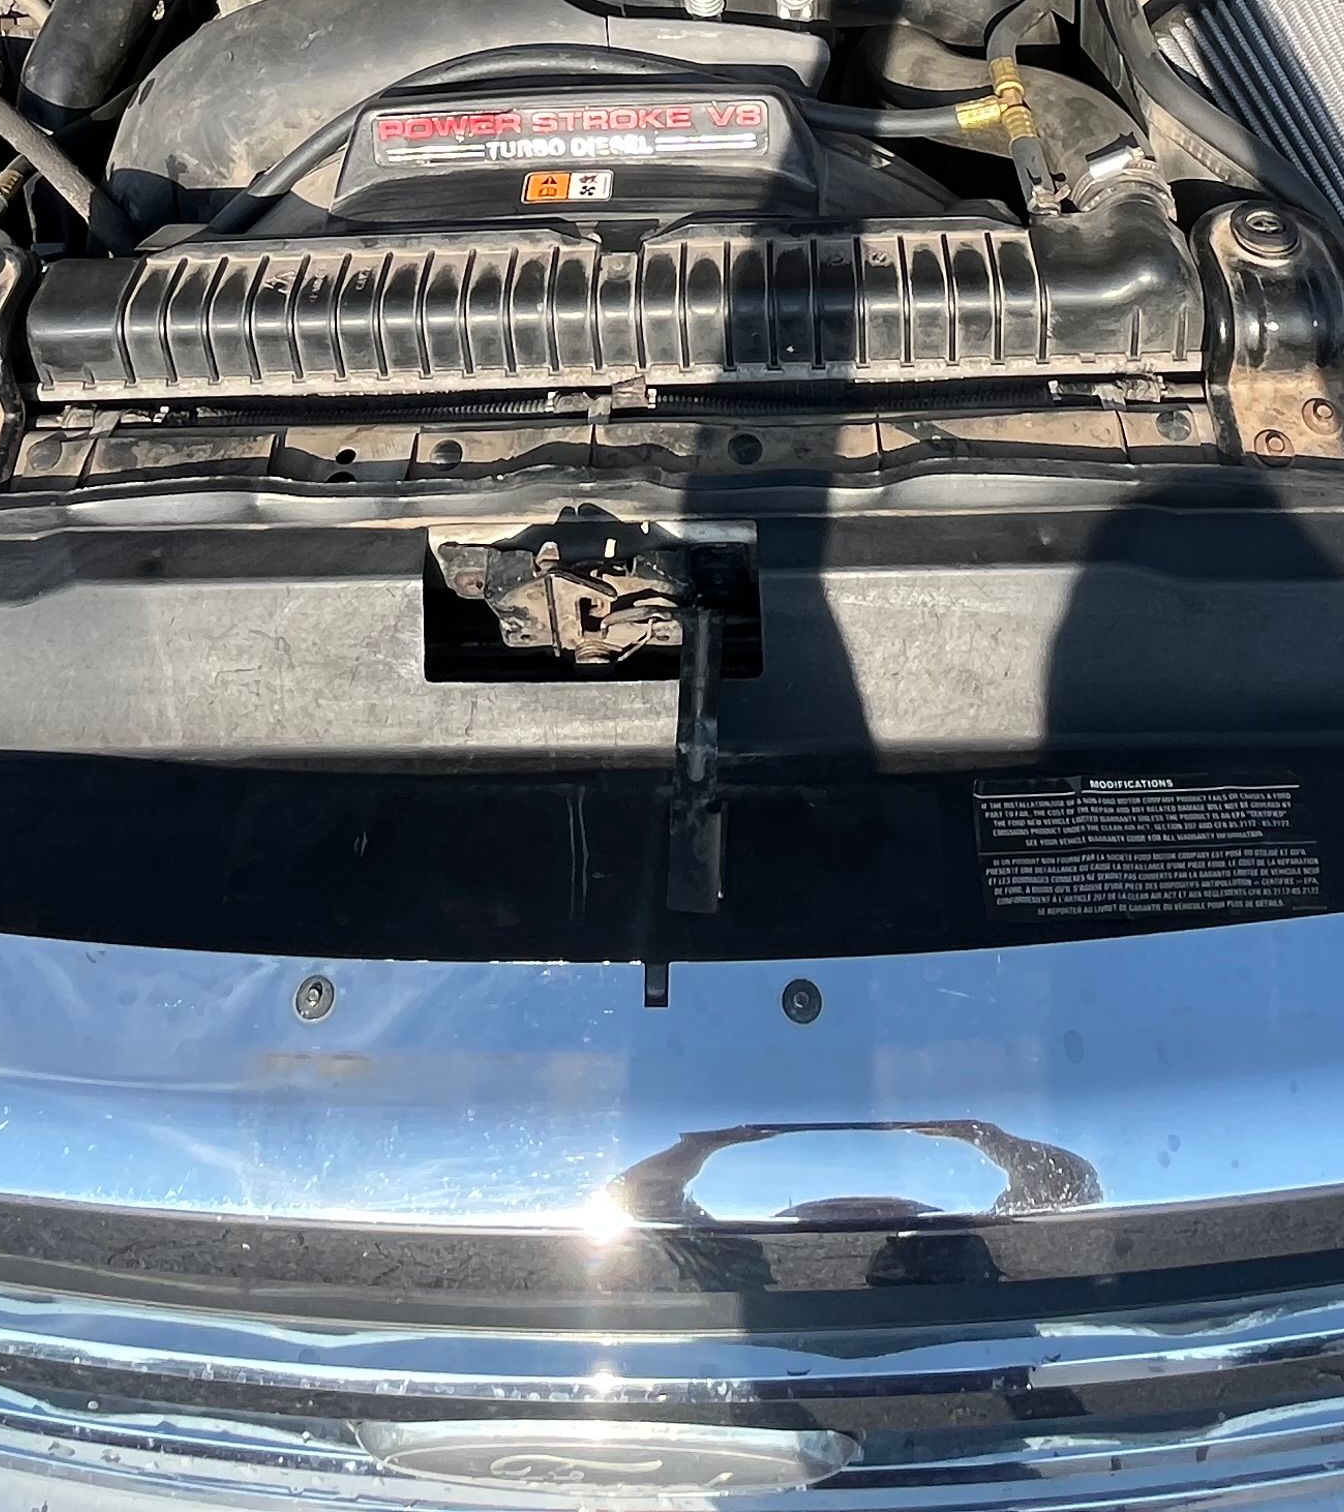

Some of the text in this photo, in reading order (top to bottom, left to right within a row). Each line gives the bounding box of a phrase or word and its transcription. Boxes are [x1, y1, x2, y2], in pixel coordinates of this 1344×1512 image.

[378, 103, 762, 141] POWER STROKE V8
[485, 133, 655, 161] TURBO DIESEL
[1089, 779, 1174, 789] MODIFICATIONS
